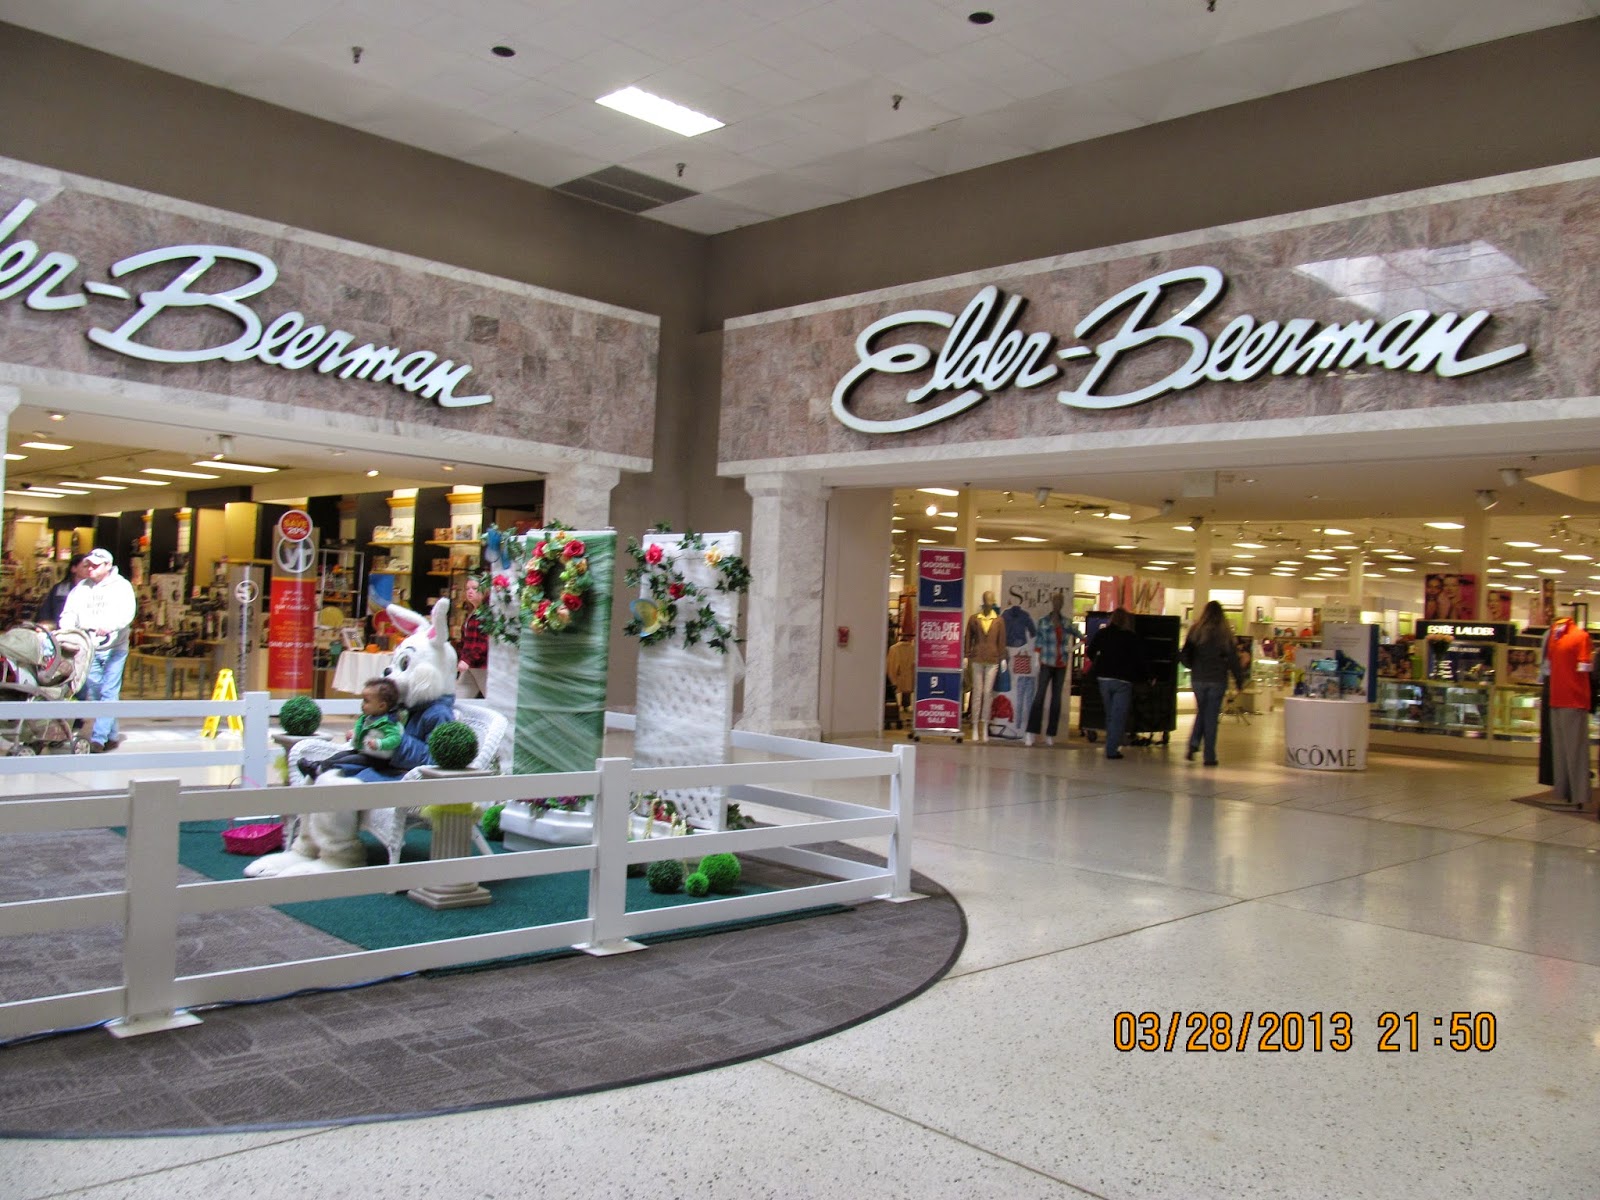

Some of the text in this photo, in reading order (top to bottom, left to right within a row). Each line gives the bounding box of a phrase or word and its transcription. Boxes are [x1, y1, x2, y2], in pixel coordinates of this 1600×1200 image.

[831, 266, 1527, 433] Elder-Beerman
[922, 561, 962, 569] GOODWILL
[942, 622, 960, 632] OFF
[1455, 626, 1494, 635] LAUDER
[921, 630, 960, 641] COUPON
